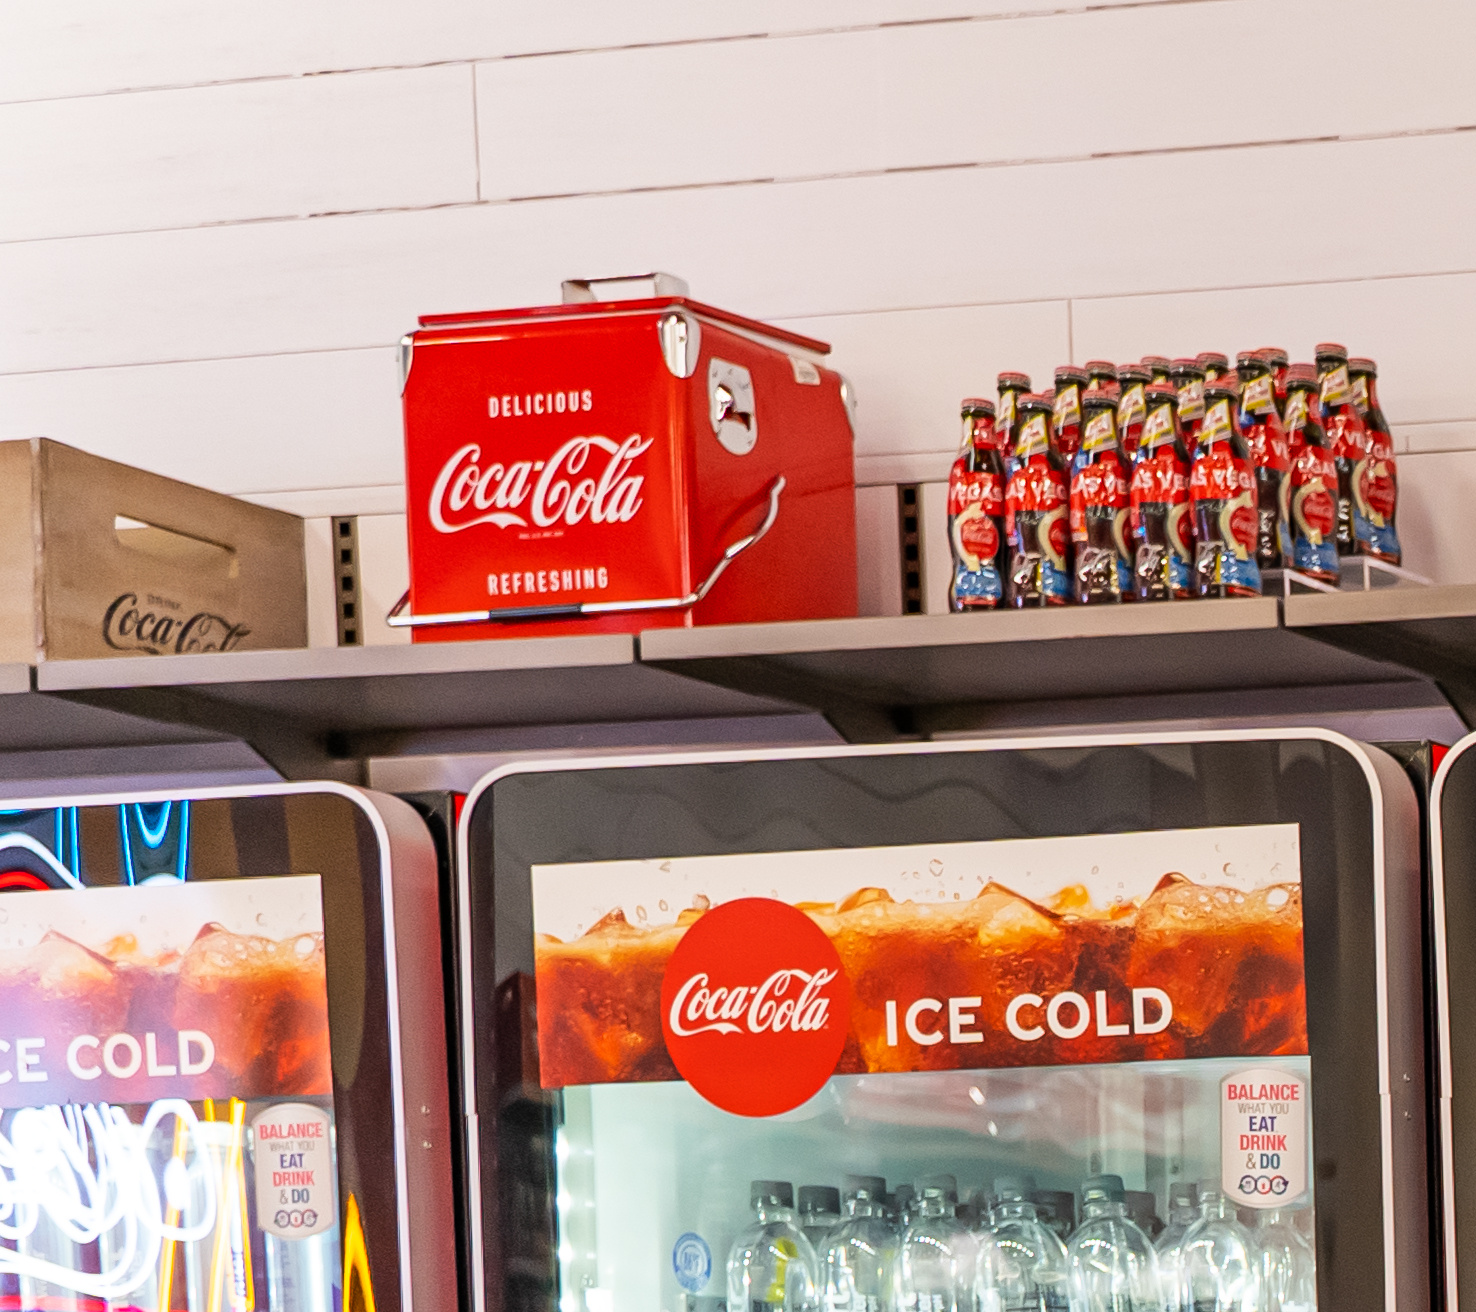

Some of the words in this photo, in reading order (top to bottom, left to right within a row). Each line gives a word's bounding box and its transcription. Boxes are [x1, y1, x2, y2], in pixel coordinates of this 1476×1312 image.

[488, 389, 593, 418] DELICIOUS
[429, 433, 653, 534] Coca-Cola
[487, 567, 609, 596] REFRESHING
[670, 968, 838, 1036] Coca-Cola
[886, 996, 984, 1046] ICE
[1005, 987, 1173, 1042] COLD
[65, 1030, 215, 1080] COLD
[1226, 1084, 1299, 1101] BALANCE
[1237, 1103, 1268, 1114] WHAT
[1269, 1103, 1290, 1114] YOU
[259, 1122, 323, 1141] BALANCE
[1238, 1134, 1288, 1152] DRINK
[1245, 1153, 1257, 1170] &
[1259, 1152, 1281, 1170] DO
[272, 1169, 316, 1188] DRINK
[291, 1188, 311, 1204] DO
